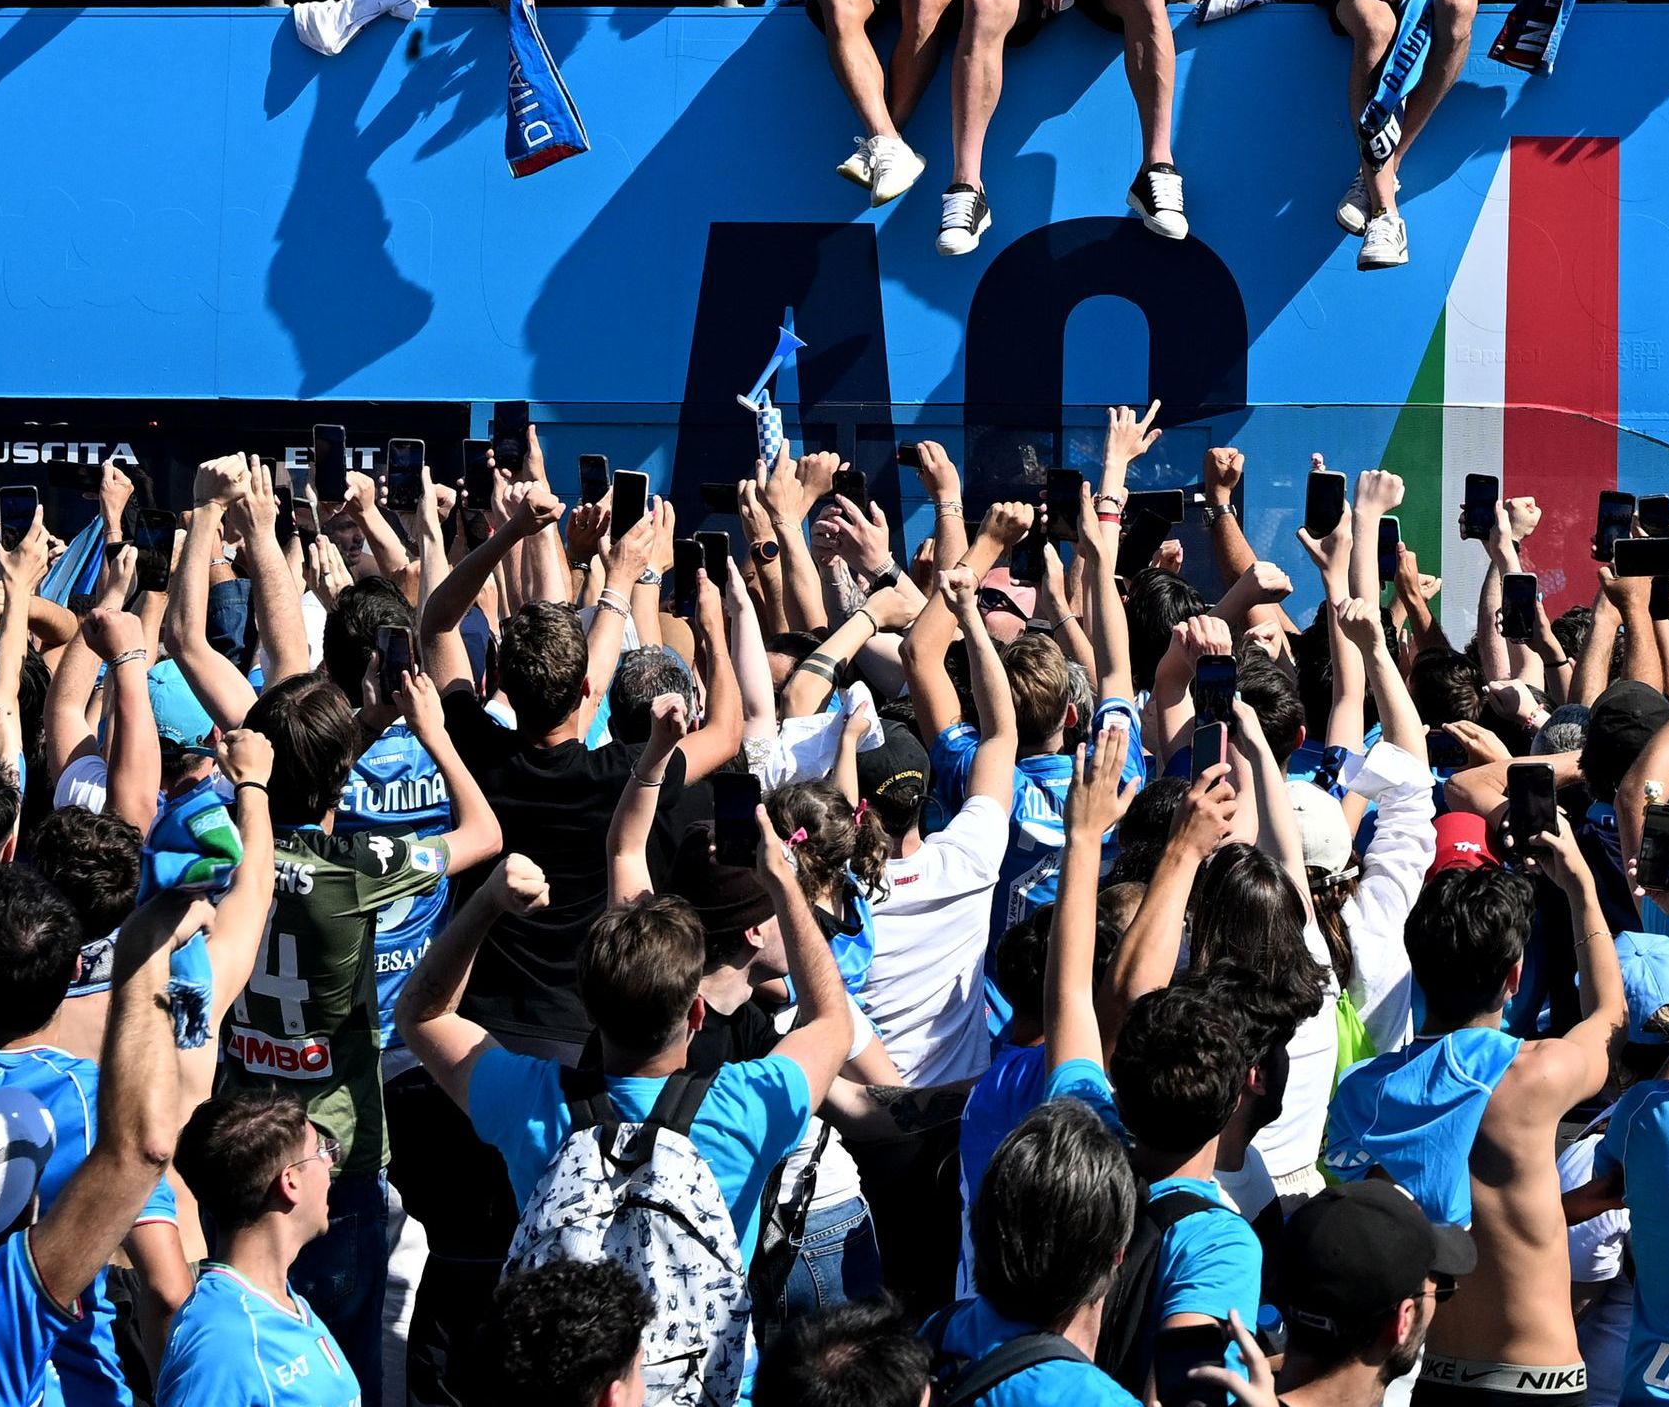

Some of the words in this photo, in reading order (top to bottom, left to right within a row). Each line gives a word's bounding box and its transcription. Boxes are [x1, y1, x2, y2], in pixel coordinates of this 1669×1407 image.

[284, 446, 381, 470] EIT
[876, 777, 895, 795] ROCKY
[895, 769, 925, 781] MOUNTAIN
[234, 902, 310, 1036] 4
[274, 1354, 310, 1387] EA7
[1517, 1368, 1586, 1392] NIKE
